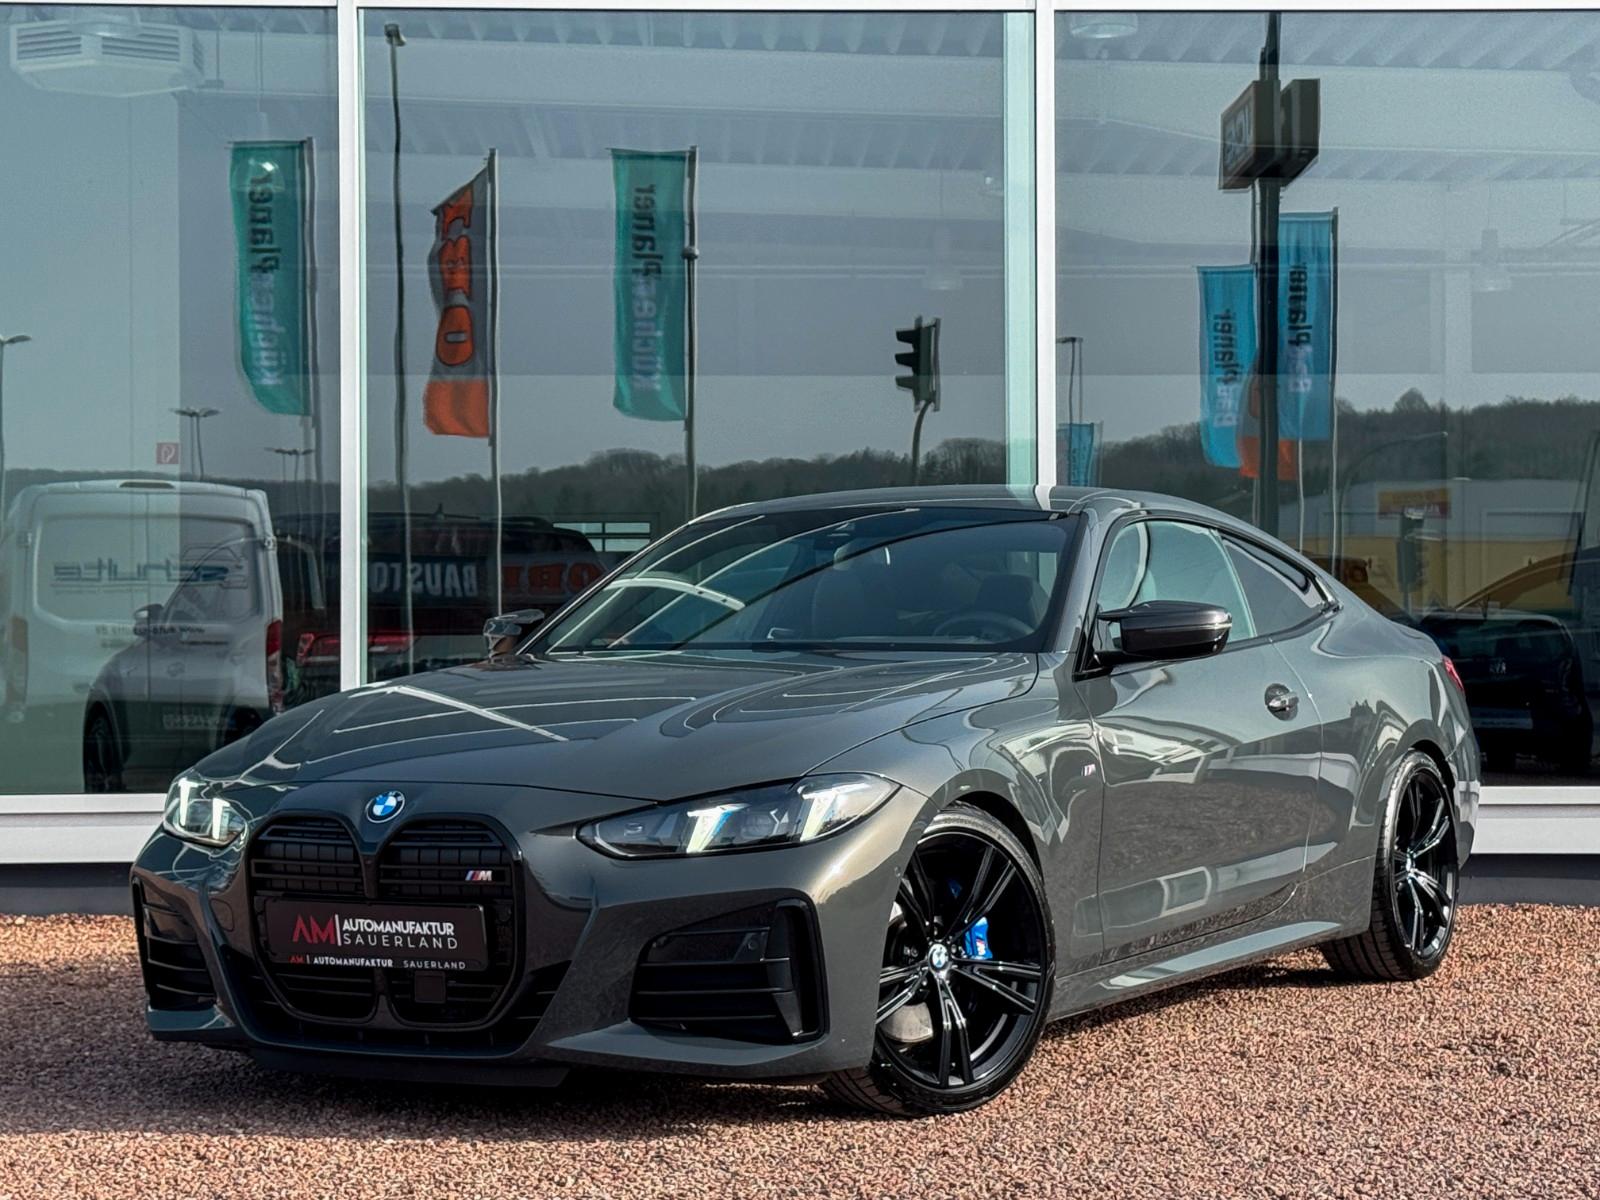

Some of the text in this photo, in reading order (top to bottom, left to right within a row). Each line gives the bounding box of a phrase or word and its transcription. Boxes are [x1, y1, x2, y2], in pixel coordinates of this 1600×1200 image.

[292, 914, 336, 944] AM
[342, 918, 455, 936] AUTOMANUFAKTUR
[343, 933, 458, 949] SAUERLAND
[288, 955, 466, 970] AM AUTOMANUFAKTUR SAUERLAND
